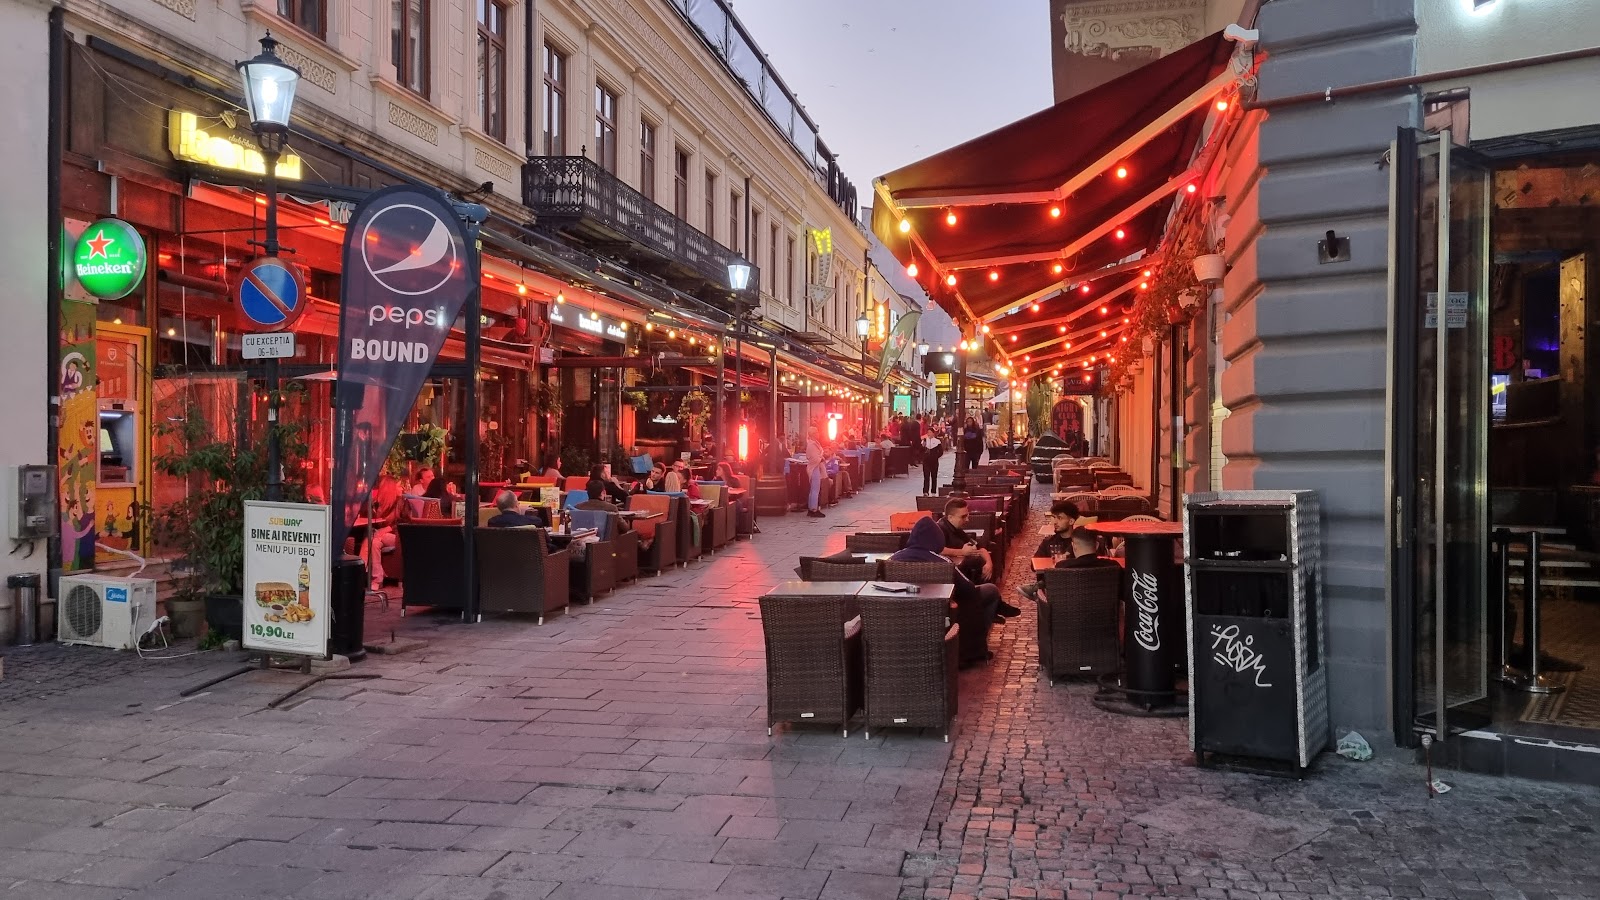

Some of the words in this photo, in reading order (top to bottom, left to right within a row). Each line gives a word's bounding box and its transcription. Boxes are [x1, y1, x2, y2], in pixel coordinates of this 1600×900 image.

[76, 261, 132, 277] Heineken
[369, 304, 445, 329] pepsi
[245, 337, 255, 346] CU
[256, 336, 290, 346] EXCEPTIA
[351, 338, 429, 363] BOUND
[268, 517, 303, 527] SUBWAY
[251, 528, 271, 540] BINE
[271, 530, 281, 541] AI
[281, 531, 321, 544] REVENIT!
[255, 544, 281, 554] MENIU
[282, 546, 296, 555] PUI
[298, 547, 316, 557] BBQ
